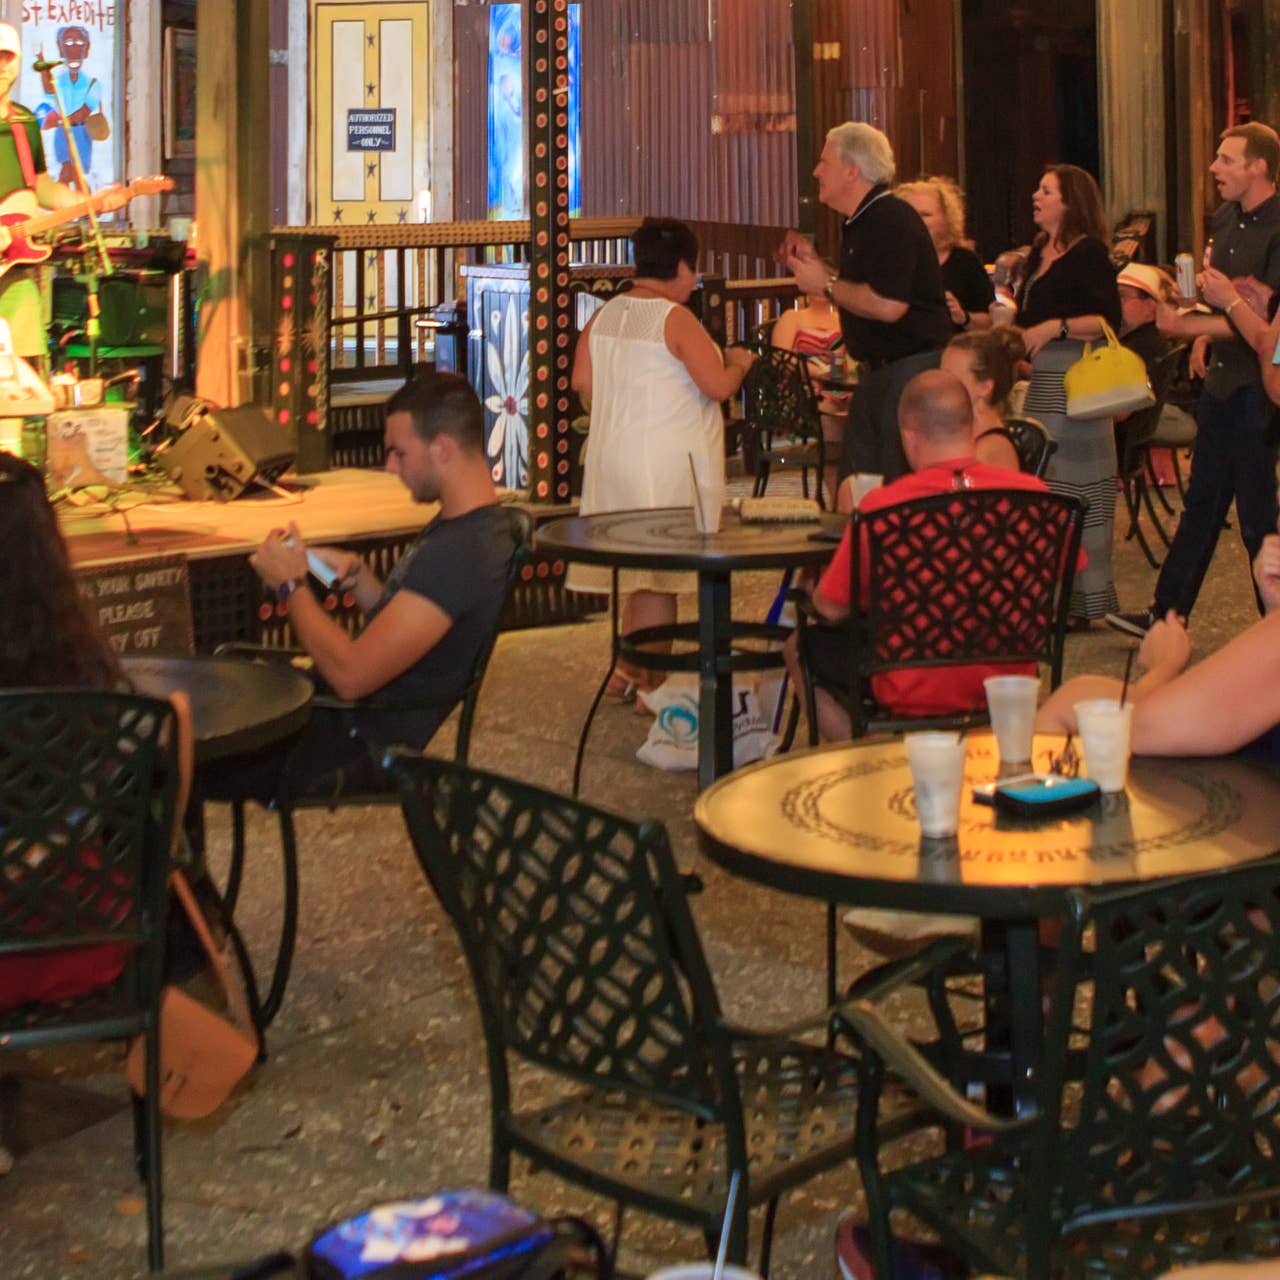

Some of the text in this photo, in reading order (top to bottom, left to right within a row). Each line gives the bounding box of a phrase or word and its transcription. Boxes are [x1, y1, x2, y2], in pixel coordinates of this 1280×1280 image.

[348, 113, 393, 123] AUTHORIZED
[349, 125, 391, 135] PERSONNEL
[360, 137, 382, 147] ONLY
[134, 566, 184, 592] SAFETY
[97, 599, 156, 627] PLEASE
[133, 625, 163, 649] OFF
